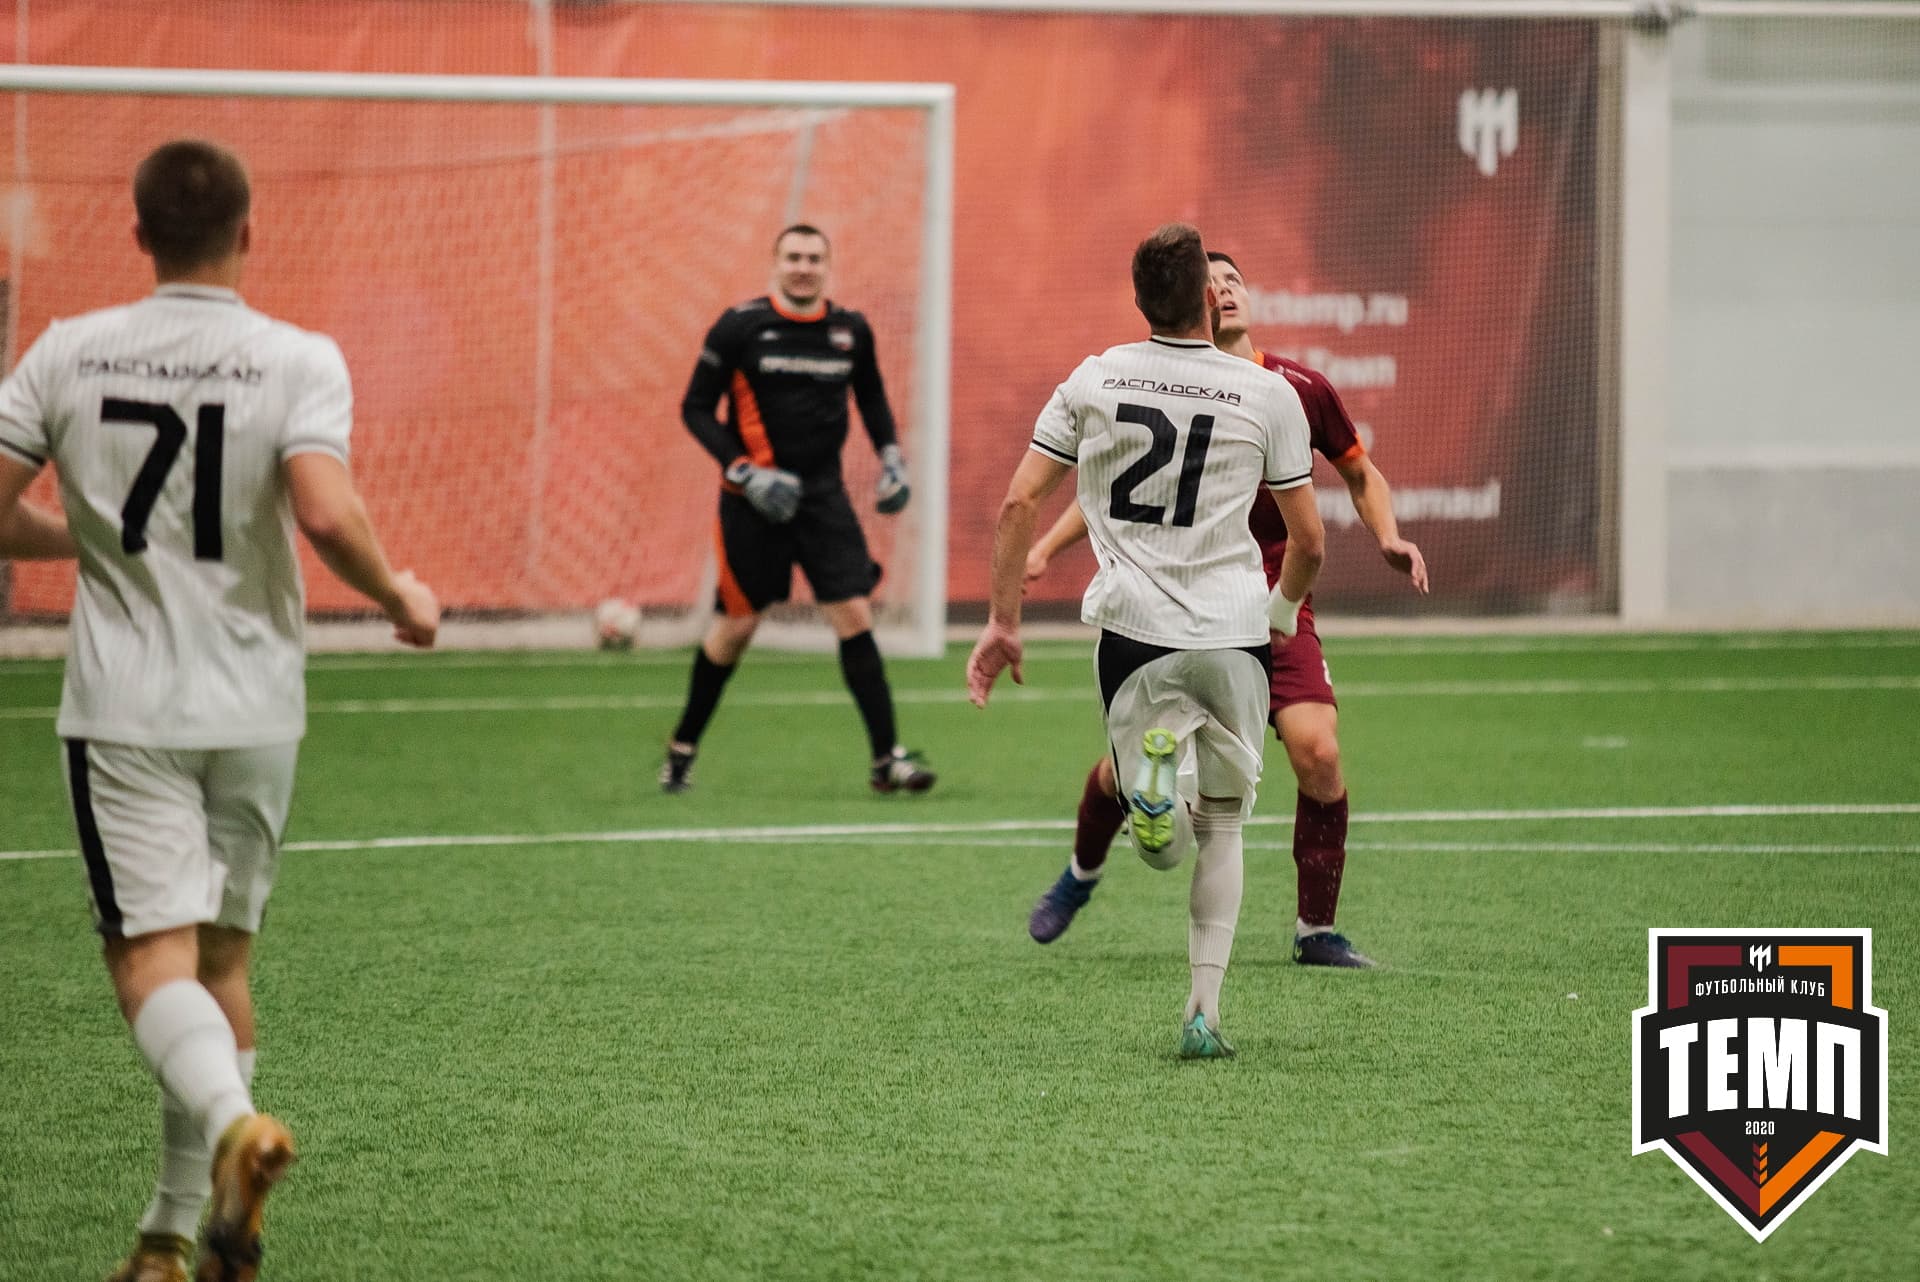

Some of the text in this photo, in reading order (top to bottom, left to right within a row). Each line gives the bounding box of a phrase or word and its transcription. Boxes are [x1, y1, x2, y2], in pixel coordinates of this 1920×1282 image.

[1102, 378, 1241, 406] РАСПАДСКАЯ
[100, 397, 225, 562] 71
[1110, 402, 1215, 527] 21
